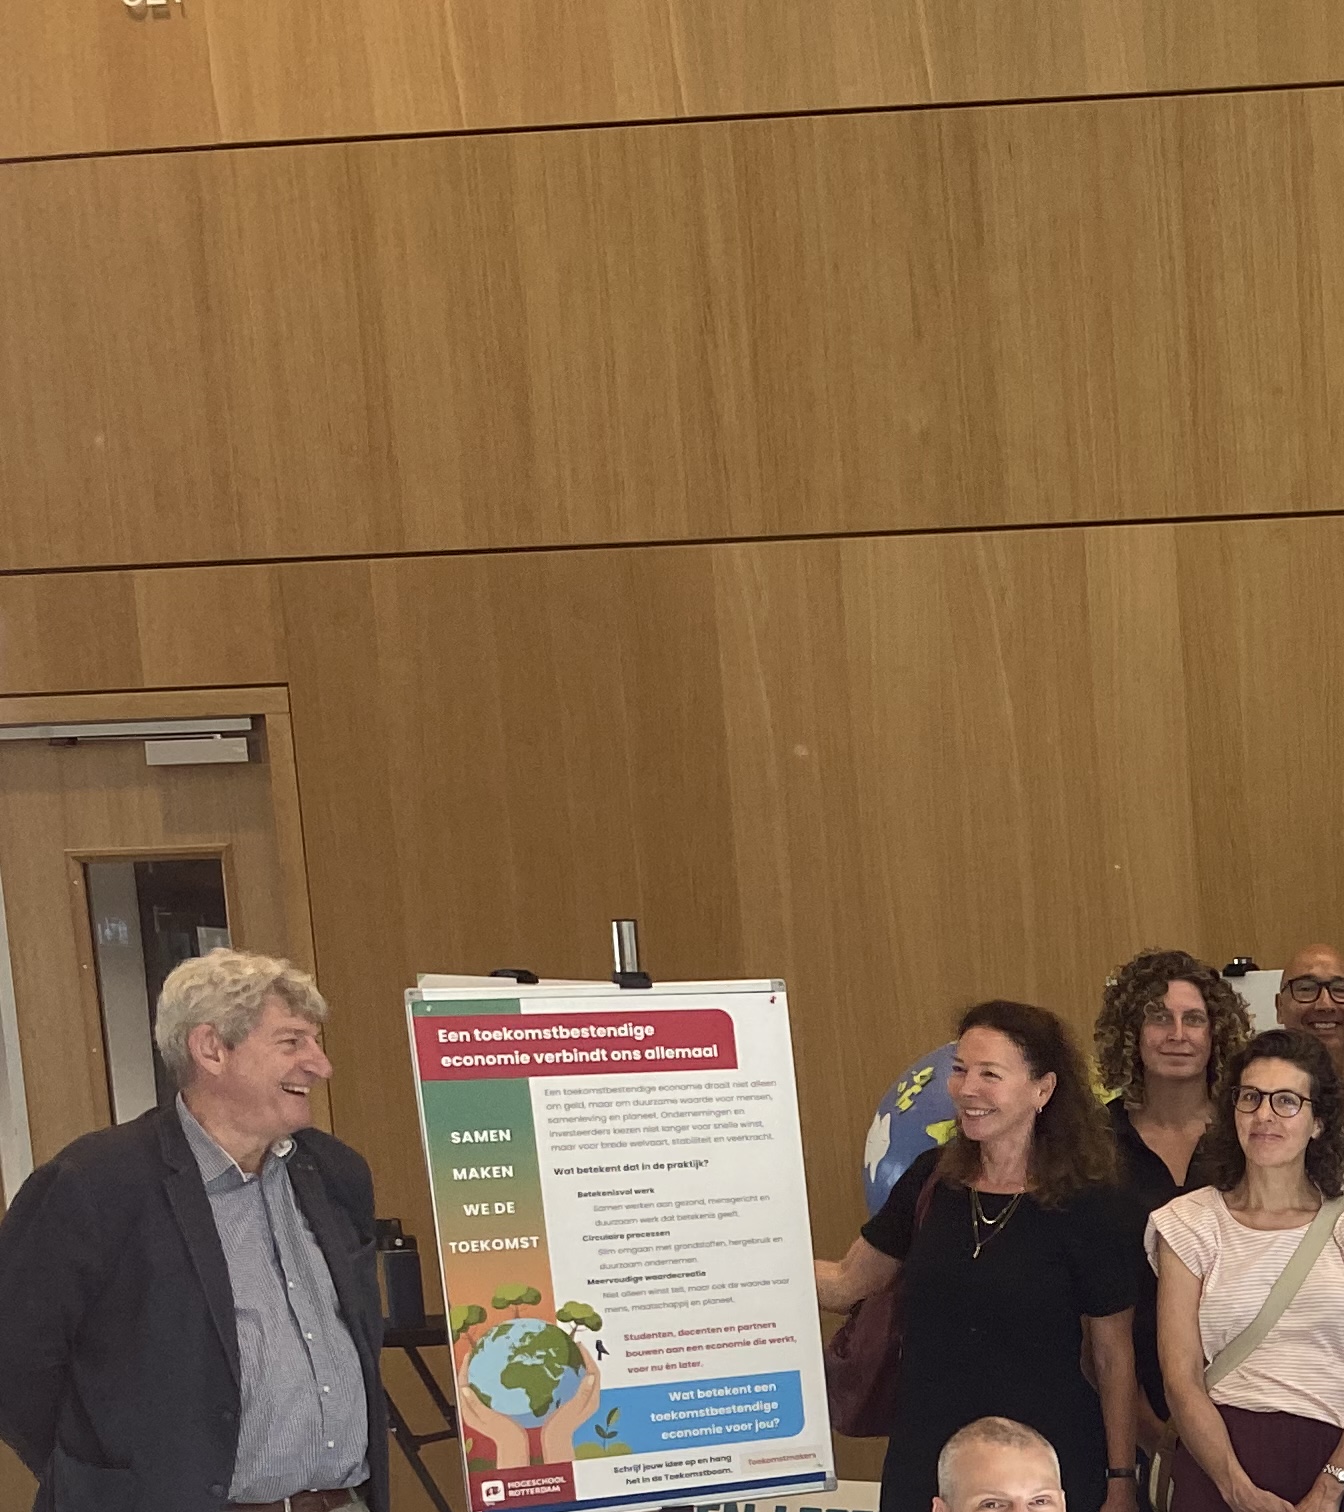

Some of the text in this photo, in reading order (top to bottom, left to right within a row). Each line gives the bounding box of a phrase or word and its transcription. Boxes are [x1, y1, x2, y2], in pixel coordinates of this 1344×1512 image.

[438, 1022, 654, 1043] Een toekomstbestendige
[441, 1044, 718, 1067] economie verbindt ons allemaal
[451, 1129, 511, 1144] SAMEN
[453, 1166, 513, 1180] MAKEN
[577, 1164, 621, 1174] betekent
[623, 1163, 639, 1172] dat
[642, 1162, 650, 1171] in
[653, 1161, 665, 1170] de
[667, 1160, 709, 1171] praktijk?
[578, 1187, 655, 1198] Betekenisvol werk
[463, 1202, 515, 1216] WE DE
[582, 1230, 670, 1242] Circulaire processen
[449, 1236, 539, 1254] TOEKOMST
[587, 1270, 706, 1285] Meervoudige waardecreatie
[678, 1327, 722, 1336] docenten
[737, 1322, 776, 1333] partners
[626, 1348, 664, 1358] bouwen
[666, 1346, 685, 1354] aan
[705, 1340, 751, 1350] economie
[753, 1338, 767, 1346] die
[627, 1365, 649, 1373] voor
[651, 1363, 663, 1371] nu
[669, 1382, 776, 1401] Wat betekent een
[651, 1401, 778, 1422] toekomstbestendige
[661, 1417, 780, 1440] economie voor jou?
[614, 1454, 732, 1474] Schrijf jouw idee op en hang
[508, 1476, 566, 1489] HOGESCHOOL
[626, 1476, 640, 1485] het
[642, 1475, 650, 1483] in
[652, 1473, 662, 1481] de
[509, 1485, 560, 1497] ROTTERDAM
